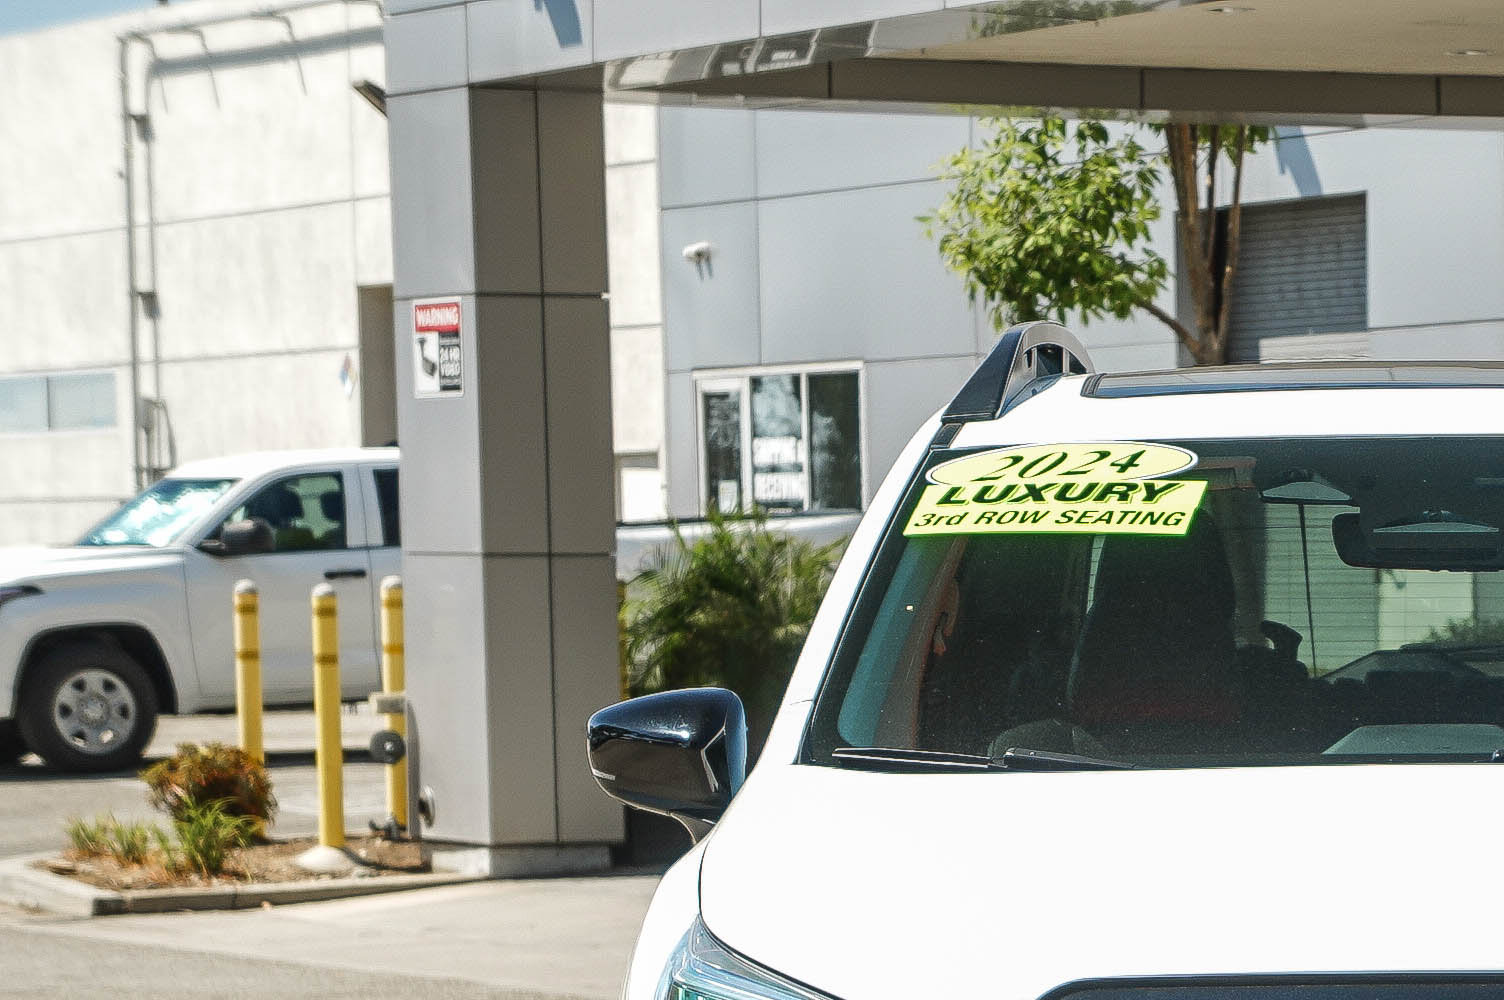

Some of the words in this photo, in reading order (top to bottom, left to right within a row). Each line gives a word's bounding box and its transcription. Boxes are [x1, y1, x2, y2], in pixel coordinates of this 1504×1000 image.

[416, 305, 459, 327] WARNING
[971, 449, 1147, 482] 2024
[935, 482, 1181, 505] LUXURY
[914, 511, 969, 528] 3rd
[973, 510, 1051, 526] ROW
[1054, 510, 1187, 527] SEATING
